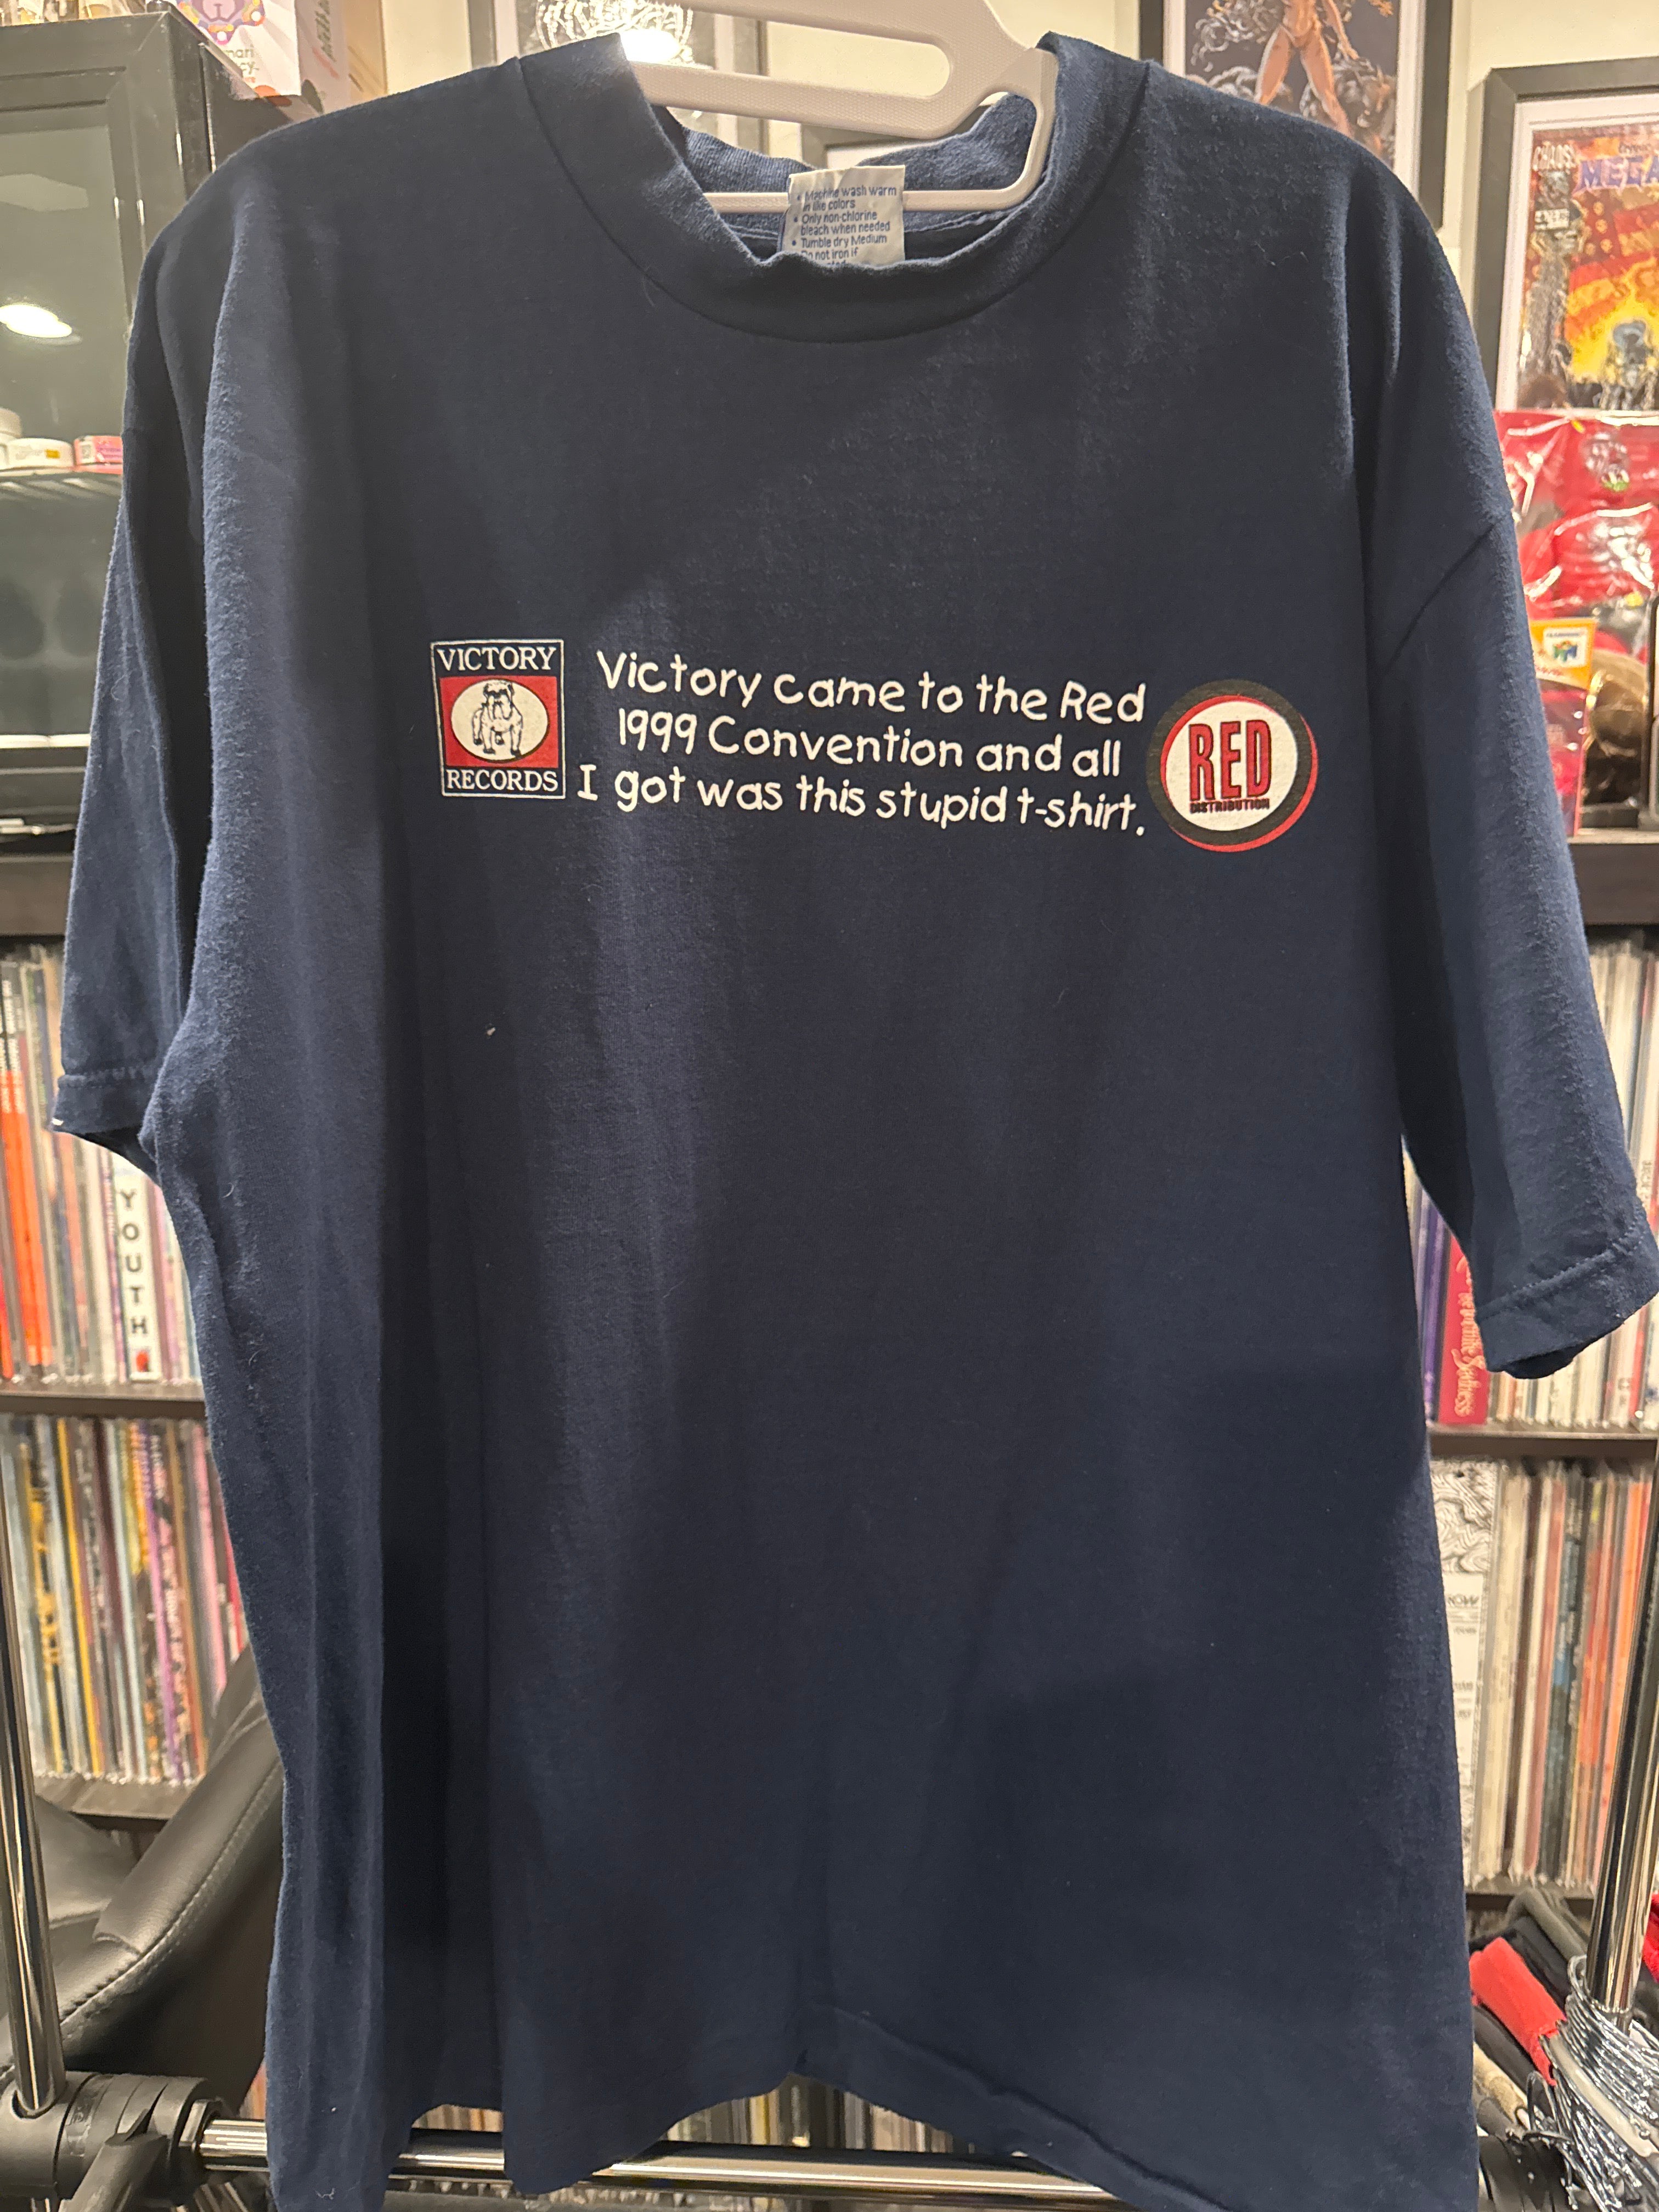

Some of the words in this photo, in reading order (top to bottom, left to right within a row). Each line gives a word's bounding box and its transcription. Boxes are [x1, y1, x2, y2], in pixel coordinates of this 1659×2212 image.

[805, 188, 839, 201] Machine
[842, 185, 867, 196] wash
[868, 187, 897, 196] warm
[803, 204, 810, 212] in
[813, 201, 826, 211] like
[828, 199, 855, 210] colors
[802, 214, 822, 225] Only
[823, 211, 877, 223] non-chlorine
[801, 224, 828, 236] bleach
[831, 223, 856, 234] when
[859, 221, 890, 233] needed
[801, 237, 831, 249] Tumble
[833, 236, 849, 249] dry
[851, 234, 887, 246] Medium
[815, 250, 831, 260] not
[832, 250, 849, 259] iron
[851, 247, 859, 257] if
[437, 646, 557, 671] VICTORY
[596, 650, 762, 708] Victory
[774, 674, 905, 713] came
[918, 671, 963, 713] to
[976, 674, 1047, 720] the
[1060, 680, 1146, 725] Red
[618, 708, 697, 755] 1999
[708, 715, 963, 768] Convention
[976, 733, 1063, 772] and
[1072, 740, 1121, 777] all
[1189, 720, 1272, 801] RED
[446, 769, 558, 792] RECORDS
[577, 764, 598, 801] I
[614, 766, 686, 812] got
[697, 778, 783, 811] was
[795, 775, 866, 817] this
[876, 781, 1008, 830] stupid
[1017, 787, 1144, 836] t-shirt.
[1190, 798, 1270, 814] DISTRIBUTION
[120, 1189, 148, 1334] YOUTH
